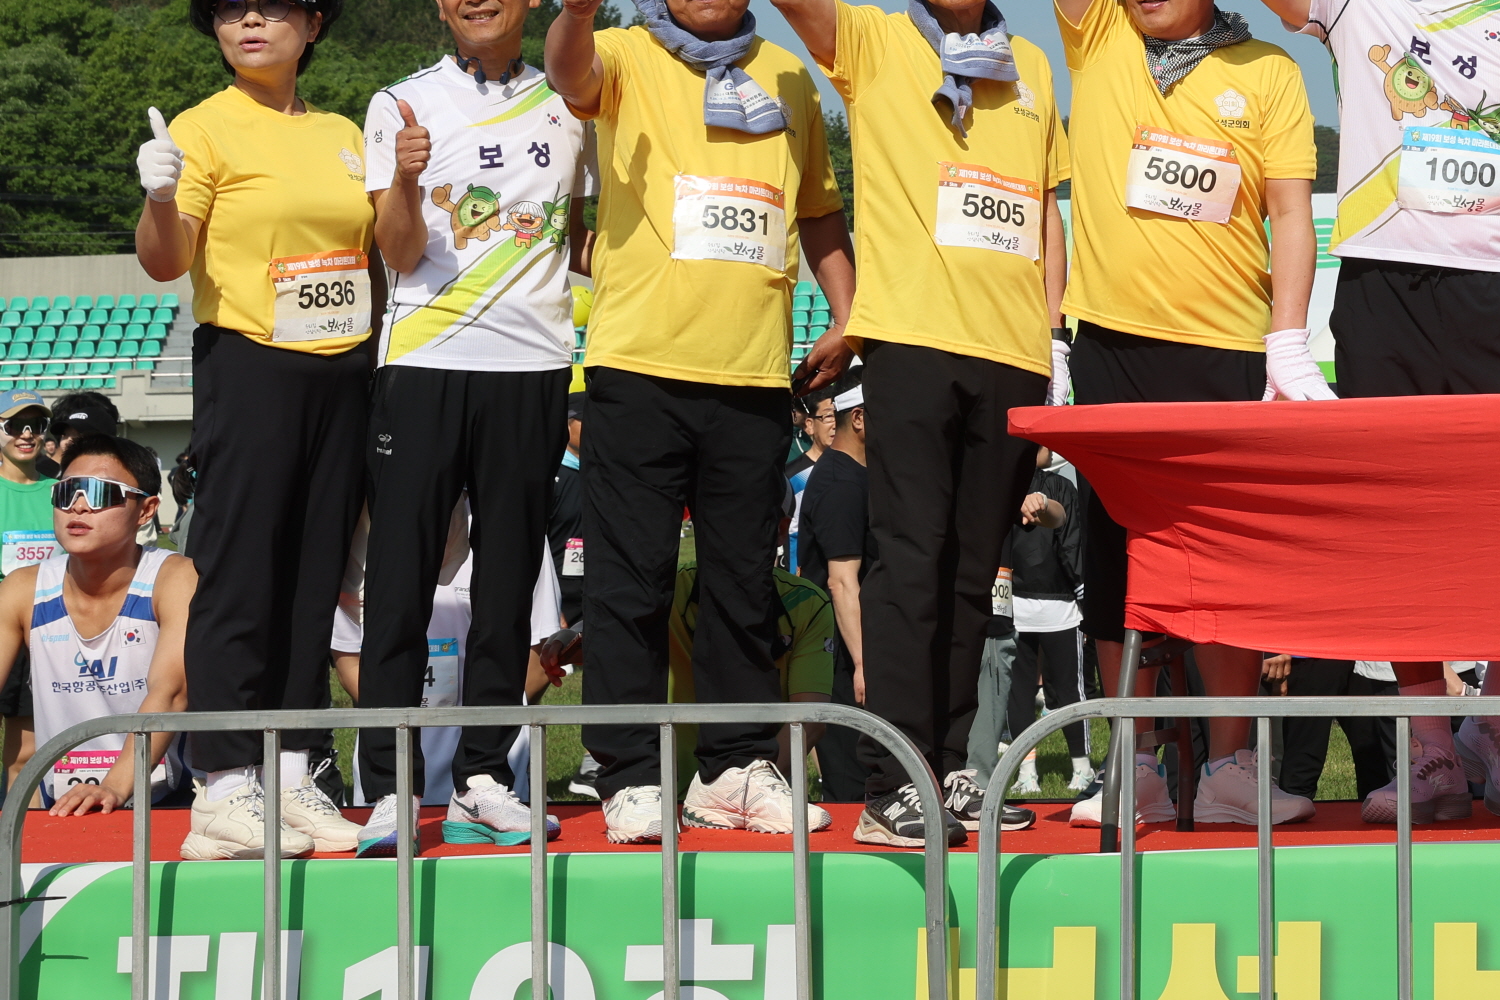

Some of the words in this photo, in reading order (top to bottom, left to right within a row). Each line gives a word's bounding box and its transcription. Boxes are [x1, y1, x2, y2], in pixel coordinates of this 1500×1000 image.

[1149, 132, 1169, 142] 제19회
[1168, 137, 1183, 147] 보성
[1182, 141, 1197, 149] 녹차
[1196, 143, 1229, 158] 마라톤대회
[1422, 133, 1443, 143] 제19회
[1443, 135, 1457, 144] 보성
[1457, 137, 1472, 146] 녹차
[958, 168, 979, 179] 제19회
[979, 172, 992, 182] 보성
[1144, 156, 1217, 193] 5800
[1425, 157, 1496, 188] 1000
[719, 183, 734, 192] 보성
[735, 184, 749, 194] 녹차
[962, 193, 1025, 227] 5805
[1167, 196, 1203, 217] 보성몰
[1451, 194, 1486, 212] 보성몰
[701, 204, 769, 236] 5831
[990, 231, 1020, 251] 보성몰
[732, 242, 765, 261] 보성몰
[286, 261, 308, 271] 제19회
[307, 259, 321, 268] 보성
[321, 257, 333, 267] 녹차
[298, 280, 355, 309] 5836
[326, 317, 355, 335] 보성몰
[16, 546, 54, 560] 3557
[69, 756, 89, 764] 제19회
[89, 756, 102, 764] 보성
[103, 756, 116, 764] 녹차
